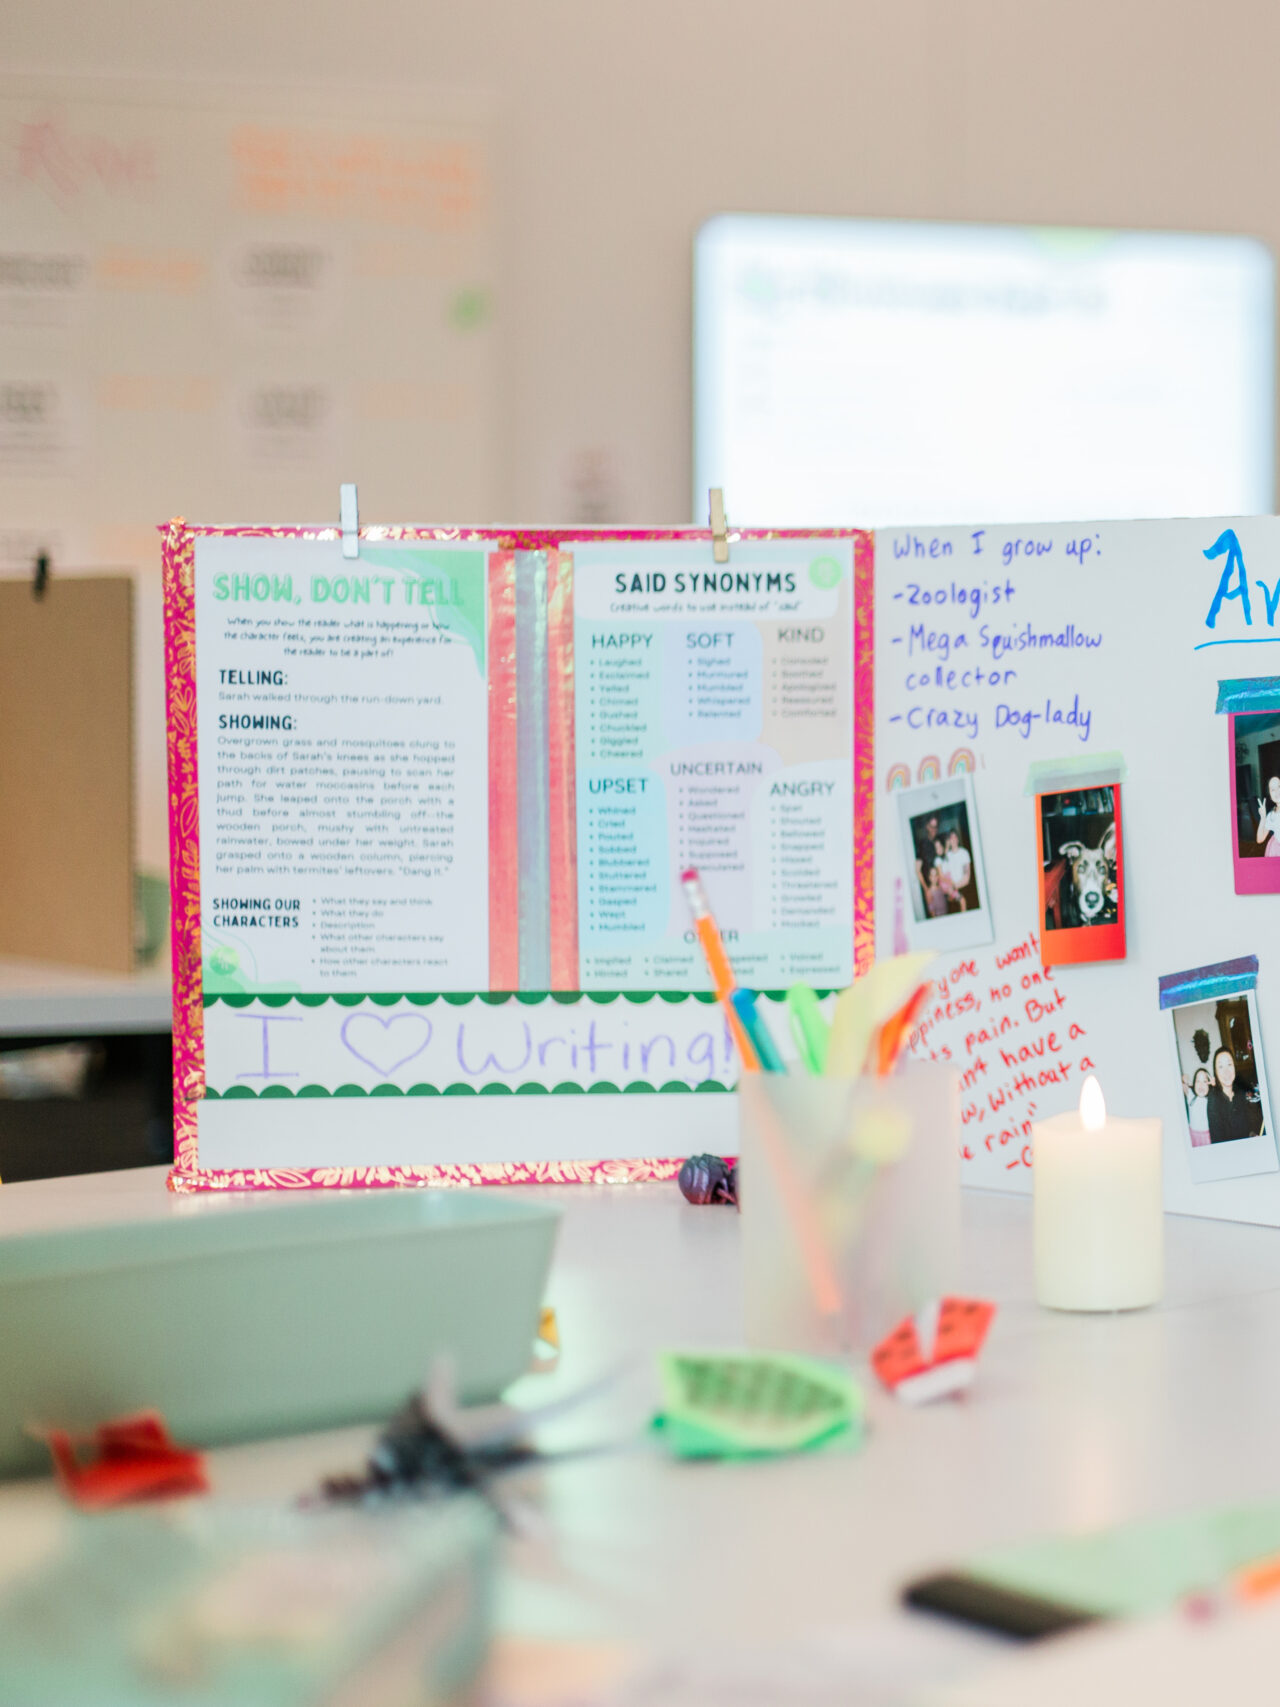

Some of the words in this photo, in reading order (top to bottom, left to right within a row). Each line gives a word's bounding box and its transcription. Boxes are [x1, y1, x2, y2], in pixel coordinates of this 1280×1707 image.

[893, 533, 953, 559] When
[971, 530, 986, 554] I
[1002, 538, 1053, 566] grow
[1066, 533, 1101, 564] up:
[212, 572, 302, 605] SHOW,
[310, 575, 395, 605] DON'T
[402, 577, 465, 606] TELL
[615, 572, 667, 593] SAID
[674, 572, 797, 592] SYNONYMS
[591, 633, 653, 648] HAPPY
[686, 632, 734, 648] SOFT
[777, 627, 825, 642] KIND
[979, 622, 1102, 660] Squishmallow
[219, 669, 288, 685] TELLING:
[906, 666, 1017, 690] collector
[218, 691, 250, 700] Sarah
[251, 692, 291, 701] walked
[293, 693, 337, 704] through
[218, 714, 297, 730] SHOWING:
[995, 694, 1091, 741] Dog-lady
[669, 761, 763, 775] UNCERTAIN
[588, 778, 648, 793] UPSET
[769, 781, 835, 796] ANGRY
[212, 898, 271, 909] SHOWING
[274, 898, 300, 910] OUR
[212, 915, 298, 927] CHARACTERS
[683, 930, 739, 943] OER
[909, 991, 981, 1053] ppiness,
[990, 984, 1012, 1001] no
[1020, 965, 1054, 990] one
[965, 1016, 1019, 1054] pain.
[1025, 988, 1066, 1023] But
[235, 1013, 303, 1079] I
[456, 1020, 733, 1085] Writing!
[1000, 1031, 1062, 1068] have
[1069, 1023, 1086, 1040] a
[1080, 1056, 1096, 1071] a
